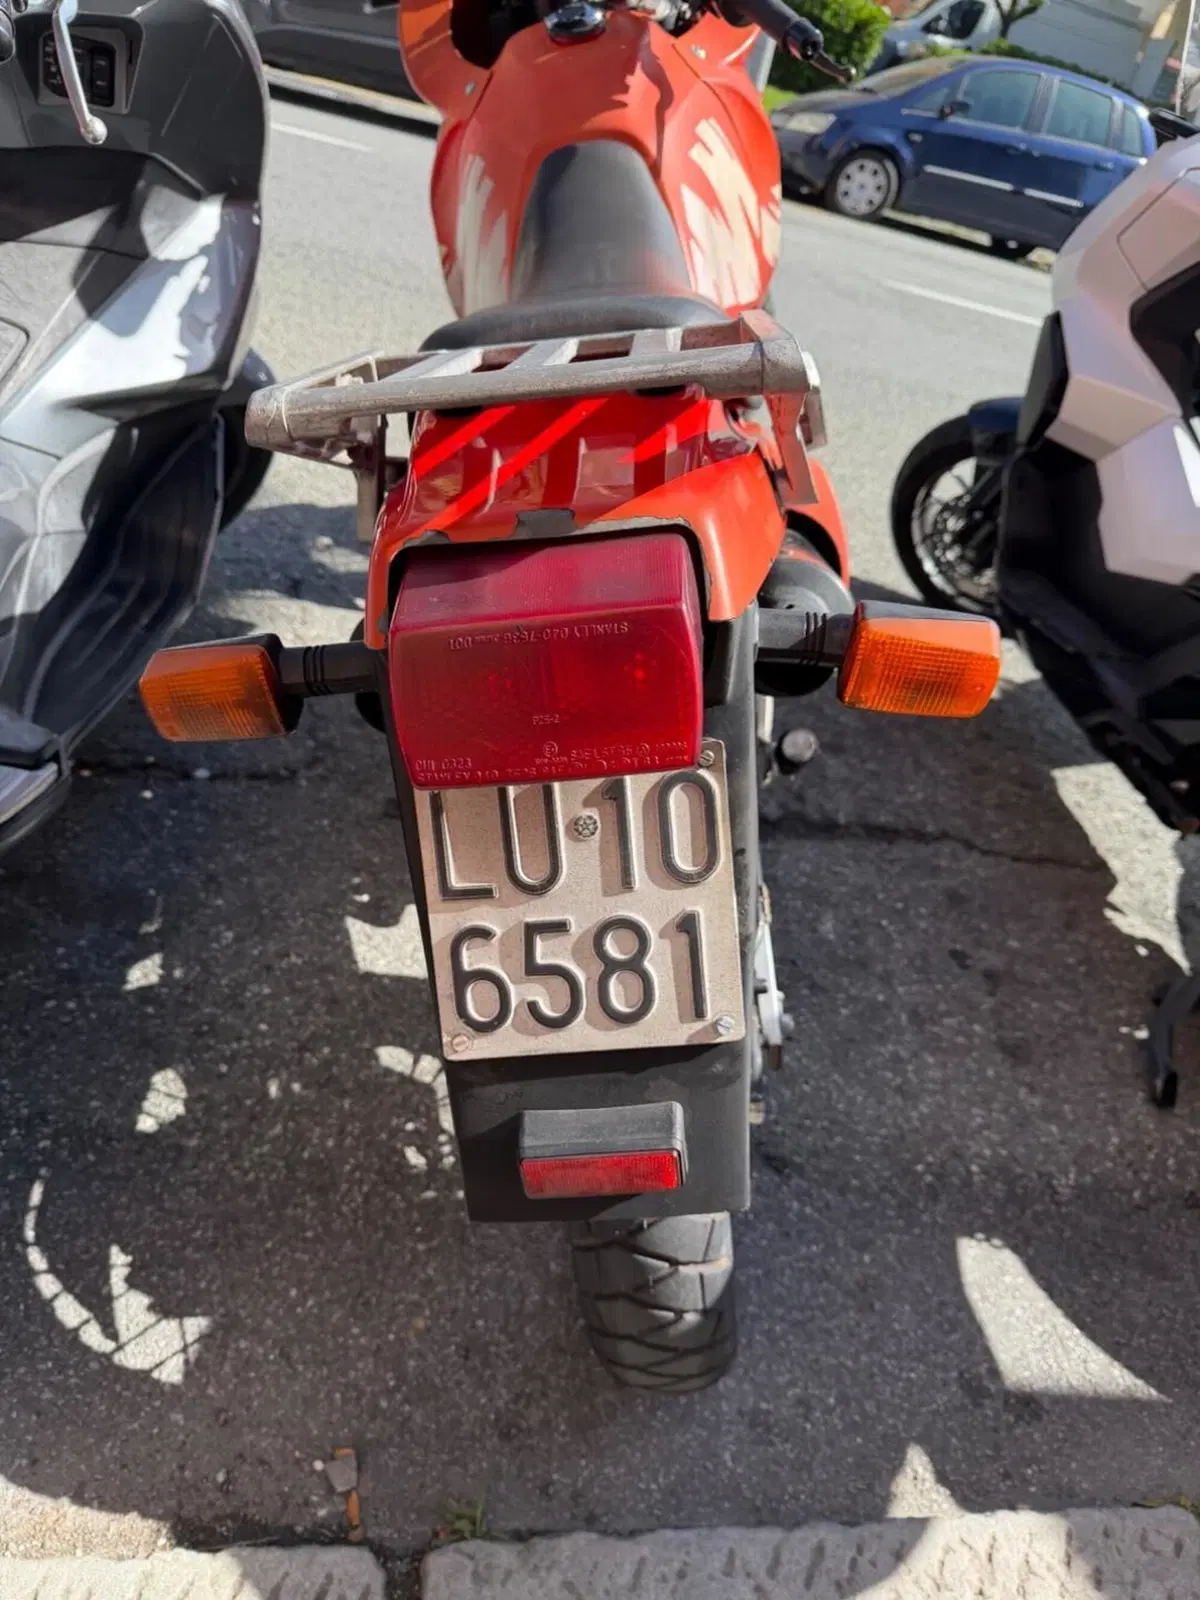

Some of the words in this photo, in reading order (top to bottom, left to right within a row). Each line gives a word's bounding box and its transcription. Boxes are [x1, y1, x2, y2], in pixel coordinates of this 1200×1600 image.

[429, 783, 564, 901] LU
[601, 769, 722, 891] 10
[450, 909, 710, 1034] 6581
